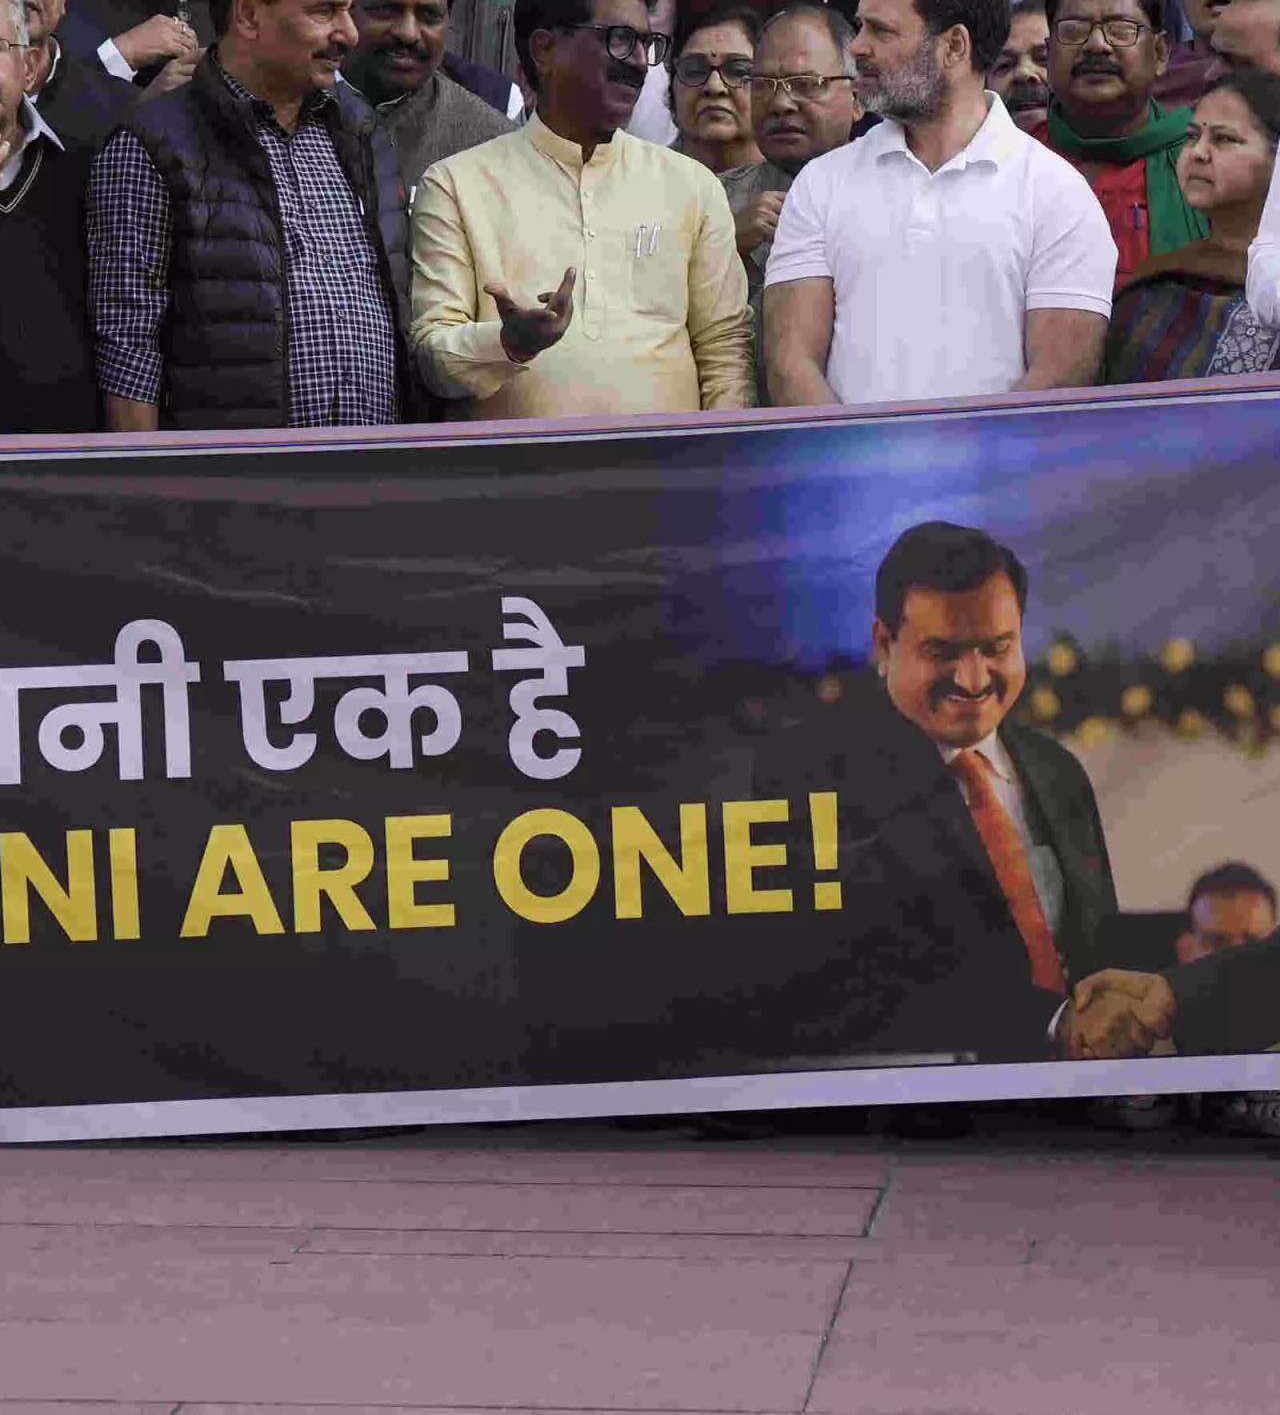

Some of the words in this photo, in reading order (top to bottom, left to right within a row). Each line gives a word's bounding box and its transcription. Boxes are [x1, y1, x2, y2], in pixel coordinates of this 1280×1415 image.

[226, 651, 467, 776] एक
[493, 596, 586, 781] है
[179, 816, 457, 938] ARE
[492, 792, 844, 924] ONE!
